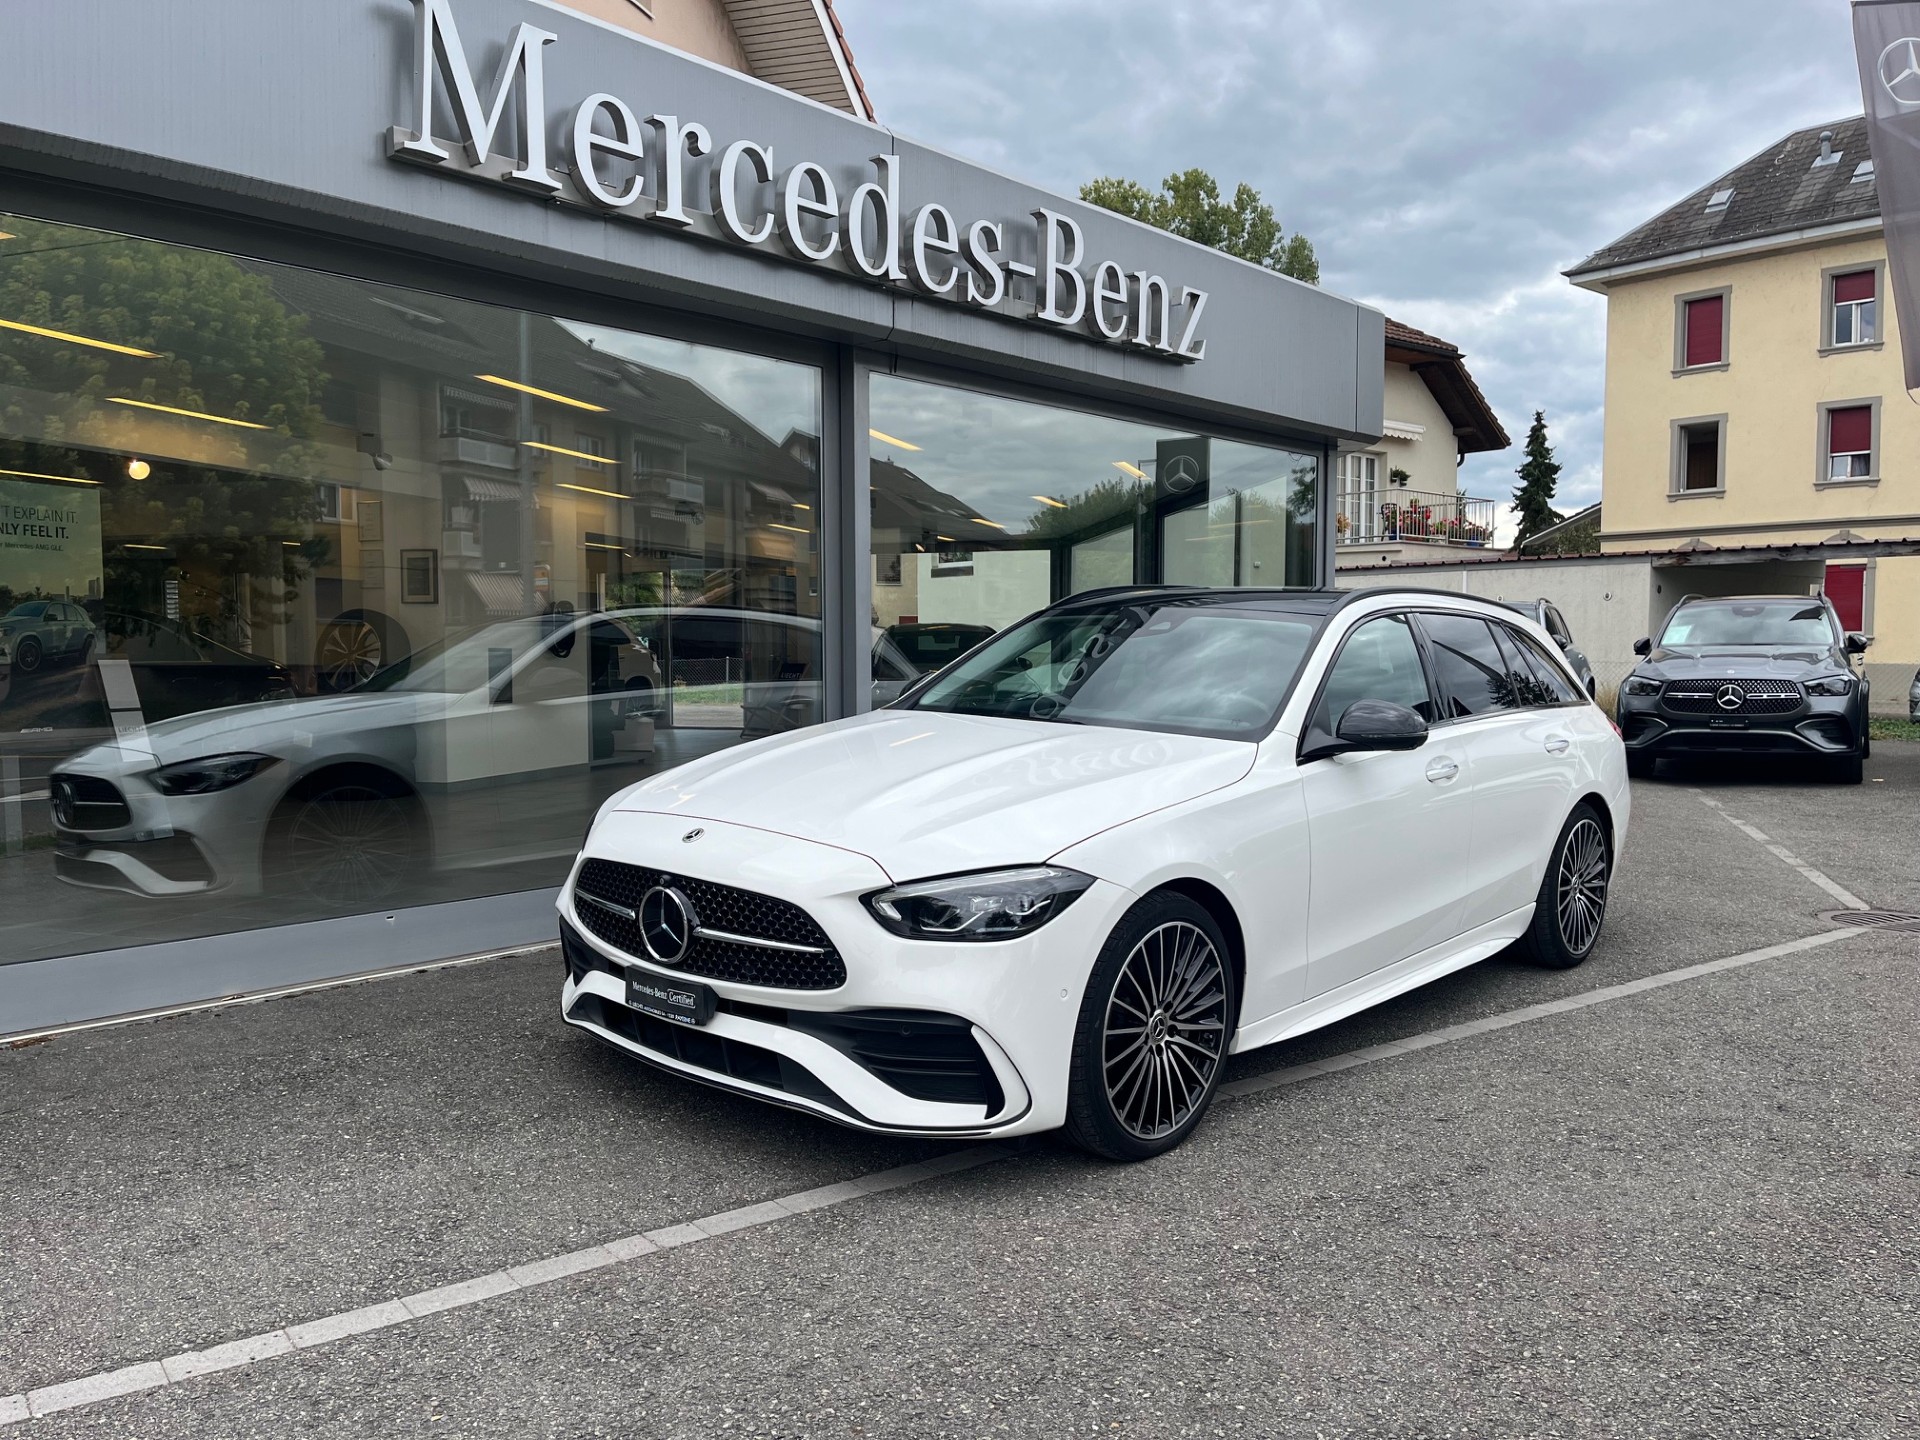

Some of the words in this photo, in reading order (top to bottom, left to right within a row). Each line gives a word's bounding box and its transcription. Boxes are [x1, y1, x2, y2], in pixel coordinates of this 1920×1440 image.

[388, 0, 1210, 363] Mercedes-Benz
[13, 506, 63, 522] EXPLAIN
[66, 511, 78, 524] IT.
[23, 524, 53, 538] FEEL
[55, 526, 69, 540] IT.
[632, 981, 667, 999] Mercedes-Benz
[668, 992, 694, 1006] Certified
